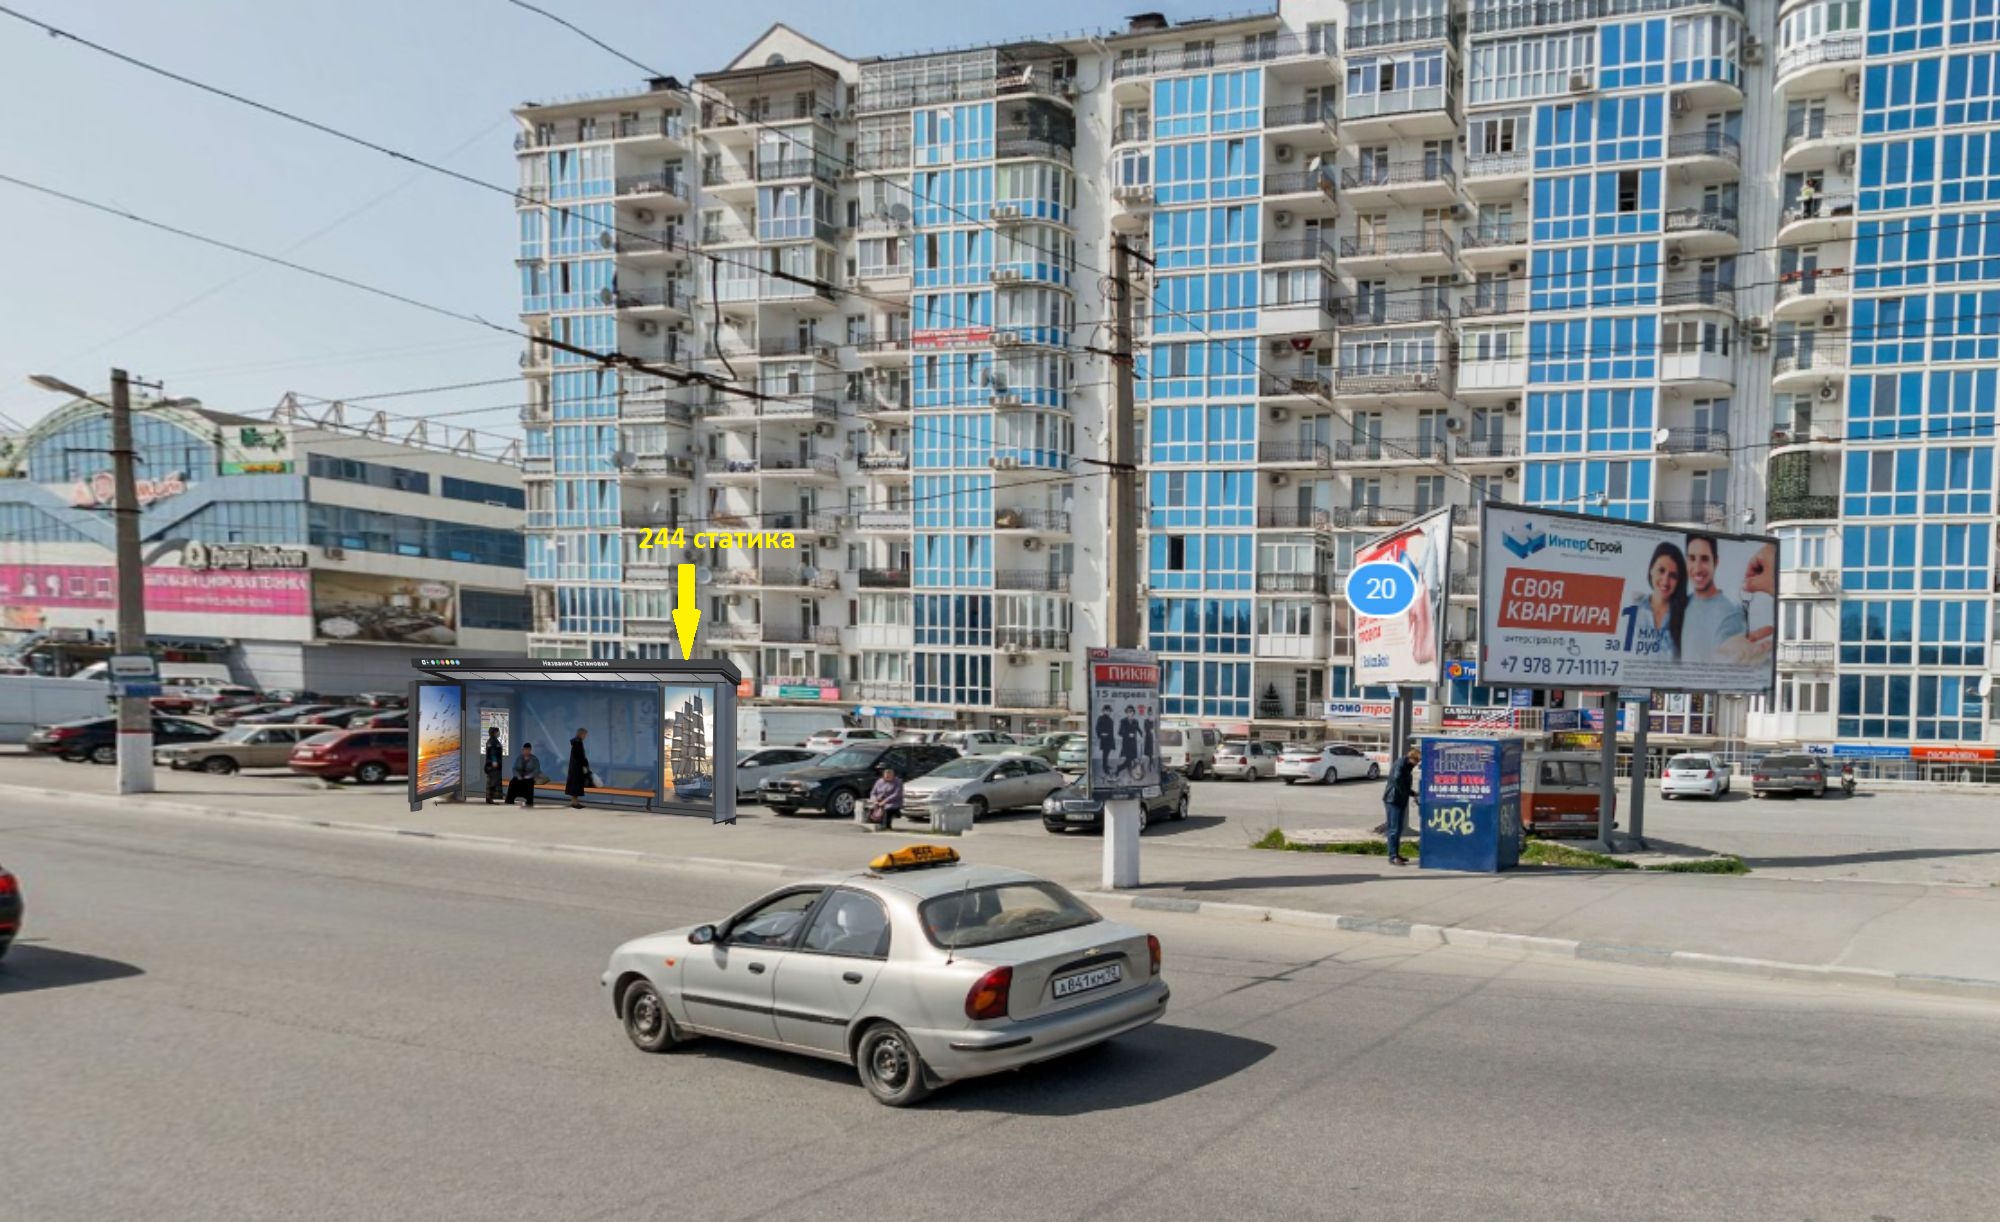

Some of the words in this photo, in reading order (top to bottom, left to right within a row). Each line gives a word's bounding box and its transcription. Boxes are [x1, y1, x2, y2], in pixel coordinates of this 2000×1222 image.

[1549, 533, 1623, 554] ИнтерСтрой
[1511, 577, 1565, 599] СВОЯ
[1506, 601, 1611, 626] КВАРТИРА
[1605, 639, 1621, 651] за
[1621, 605, 1639, 652] 1
[1500, 656, 1519, 673] +7
[1523, 657, 1552, 674] 978
[1556, 658, 1620, 676] 77-1111-7
[1096, 690, 1109, 698] 15
